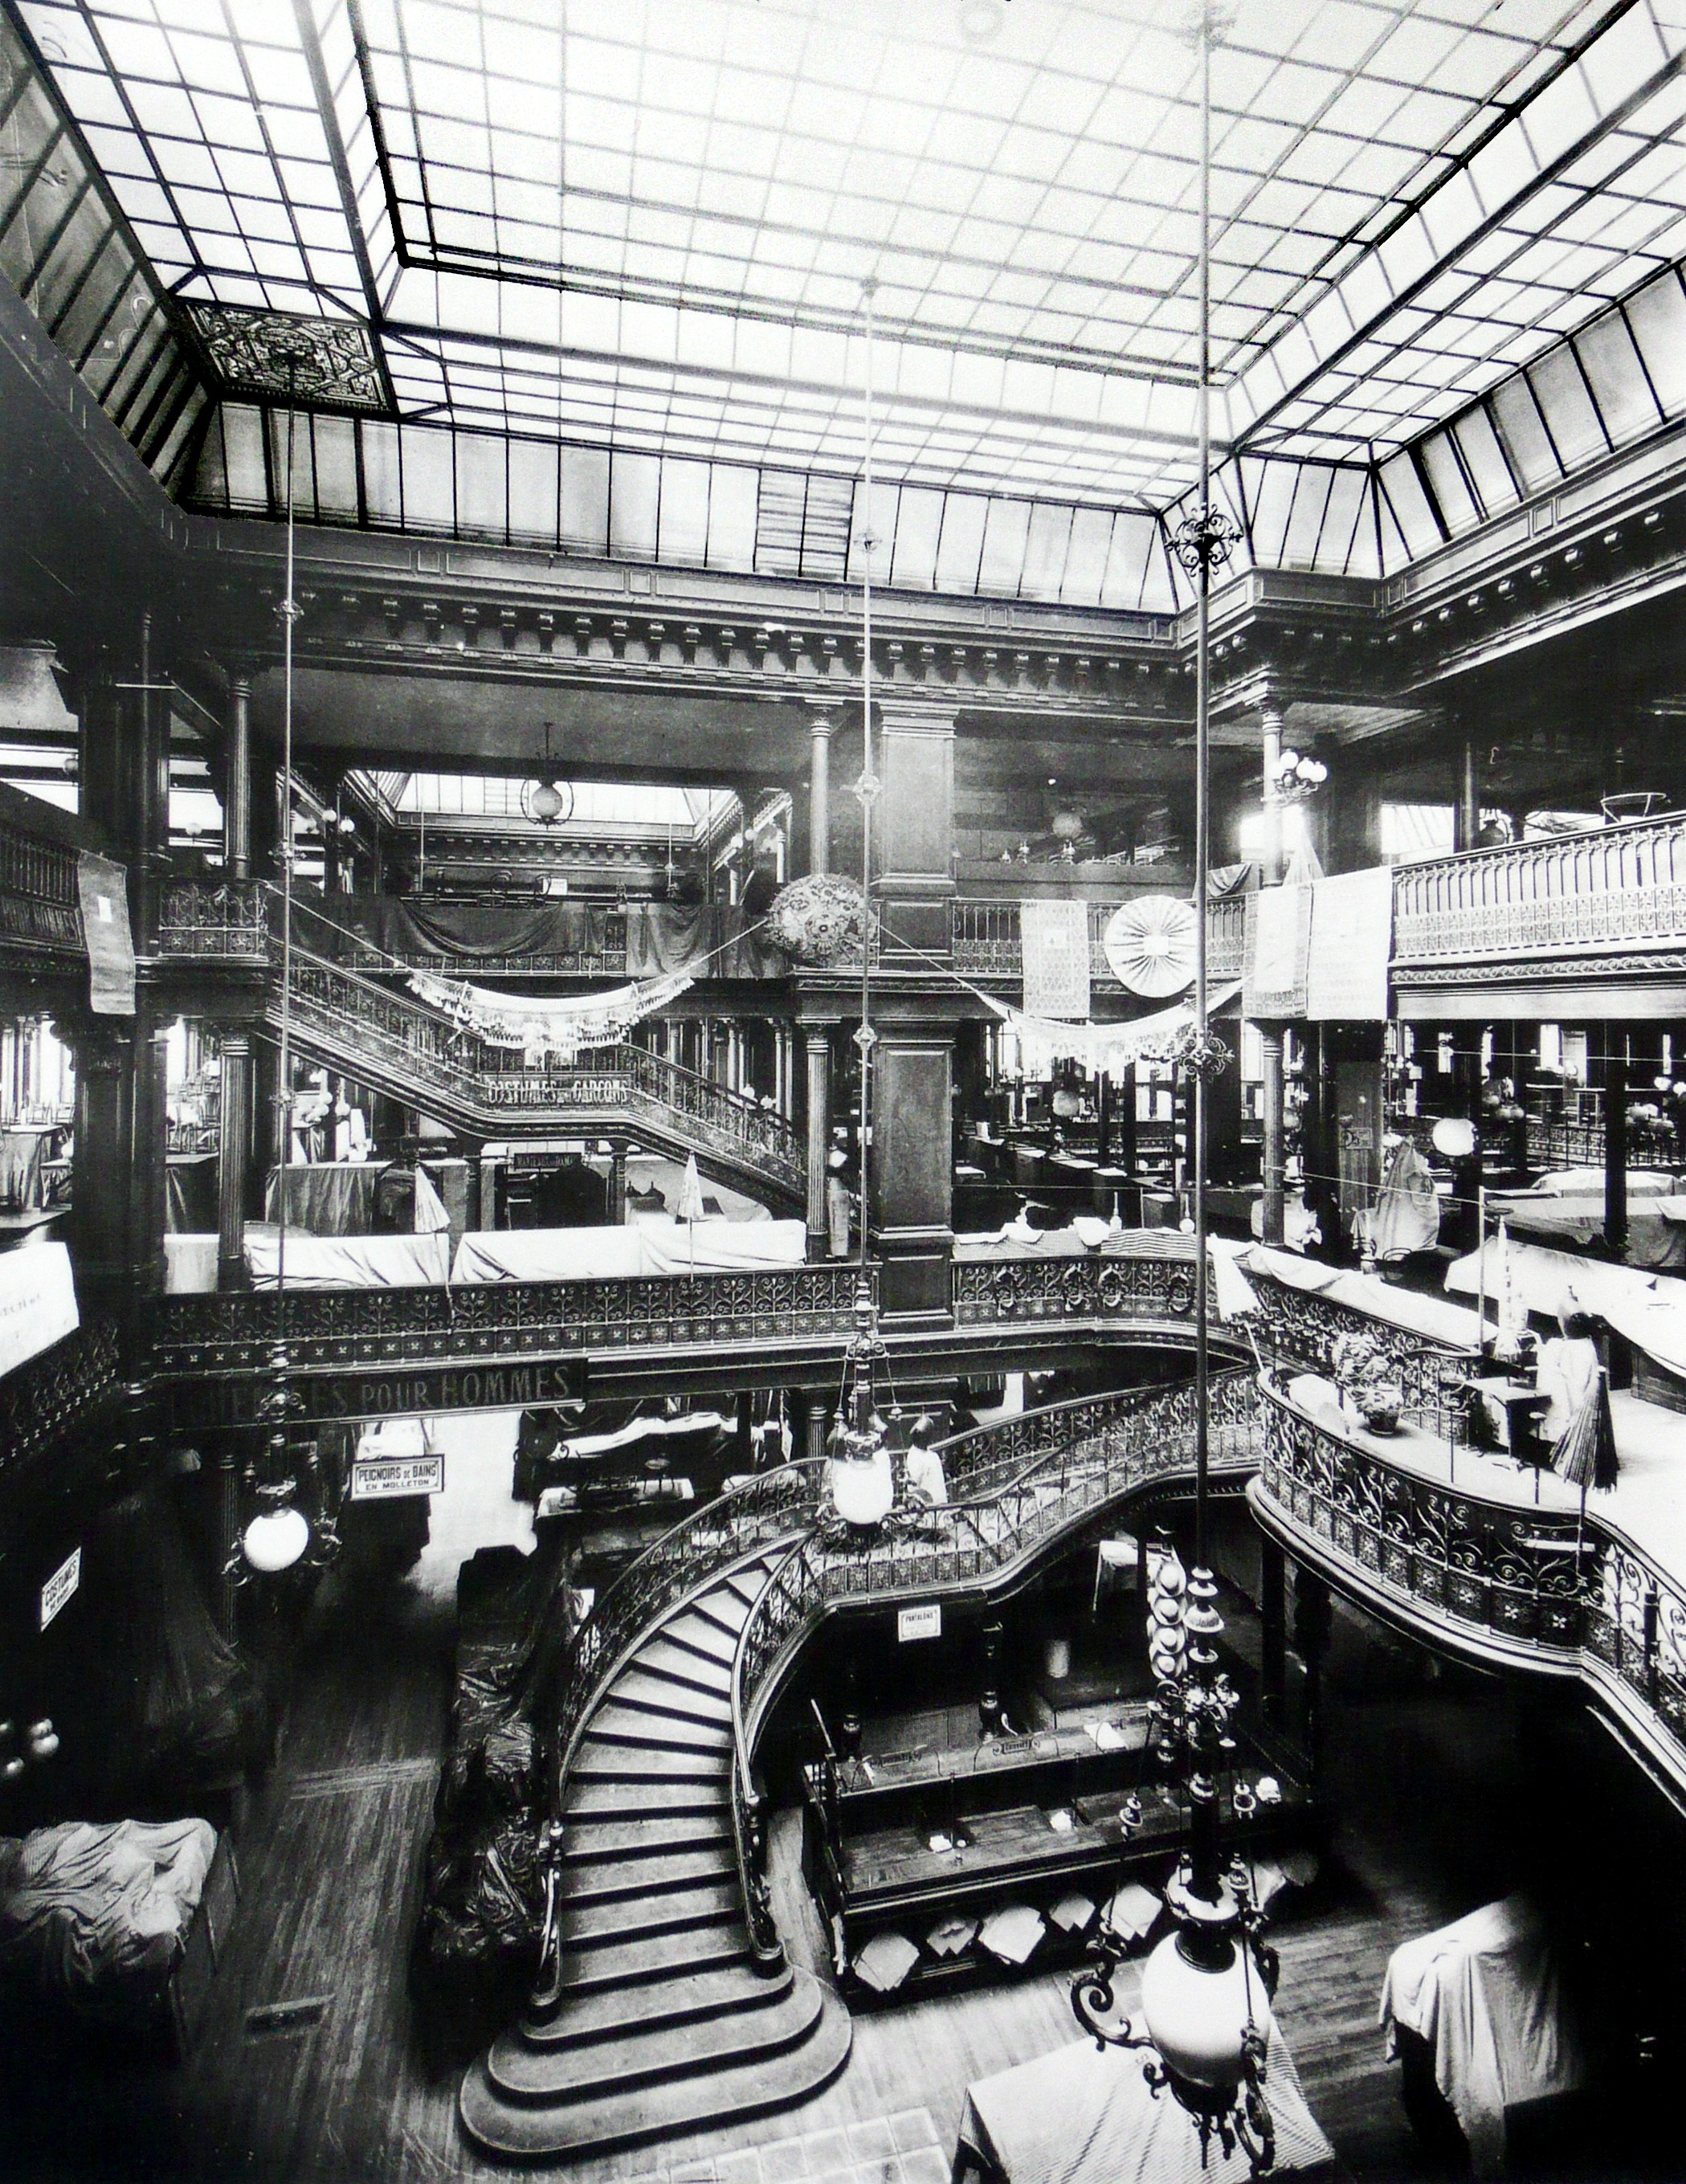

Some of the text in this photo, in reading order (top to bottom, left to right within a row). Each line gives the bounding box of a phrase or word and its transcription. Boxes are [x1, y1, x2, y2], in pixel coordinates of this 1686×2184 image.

[361, 1380, 435, 1414] POUR
[442, 1366, 569, 1406] HOMMES
[358, 1466, 401, 1483] PEIGNOIRS
[412, 1463, 436, 1478] BAINS
[365, 1479, 429, 1492] EN MOLLETON
